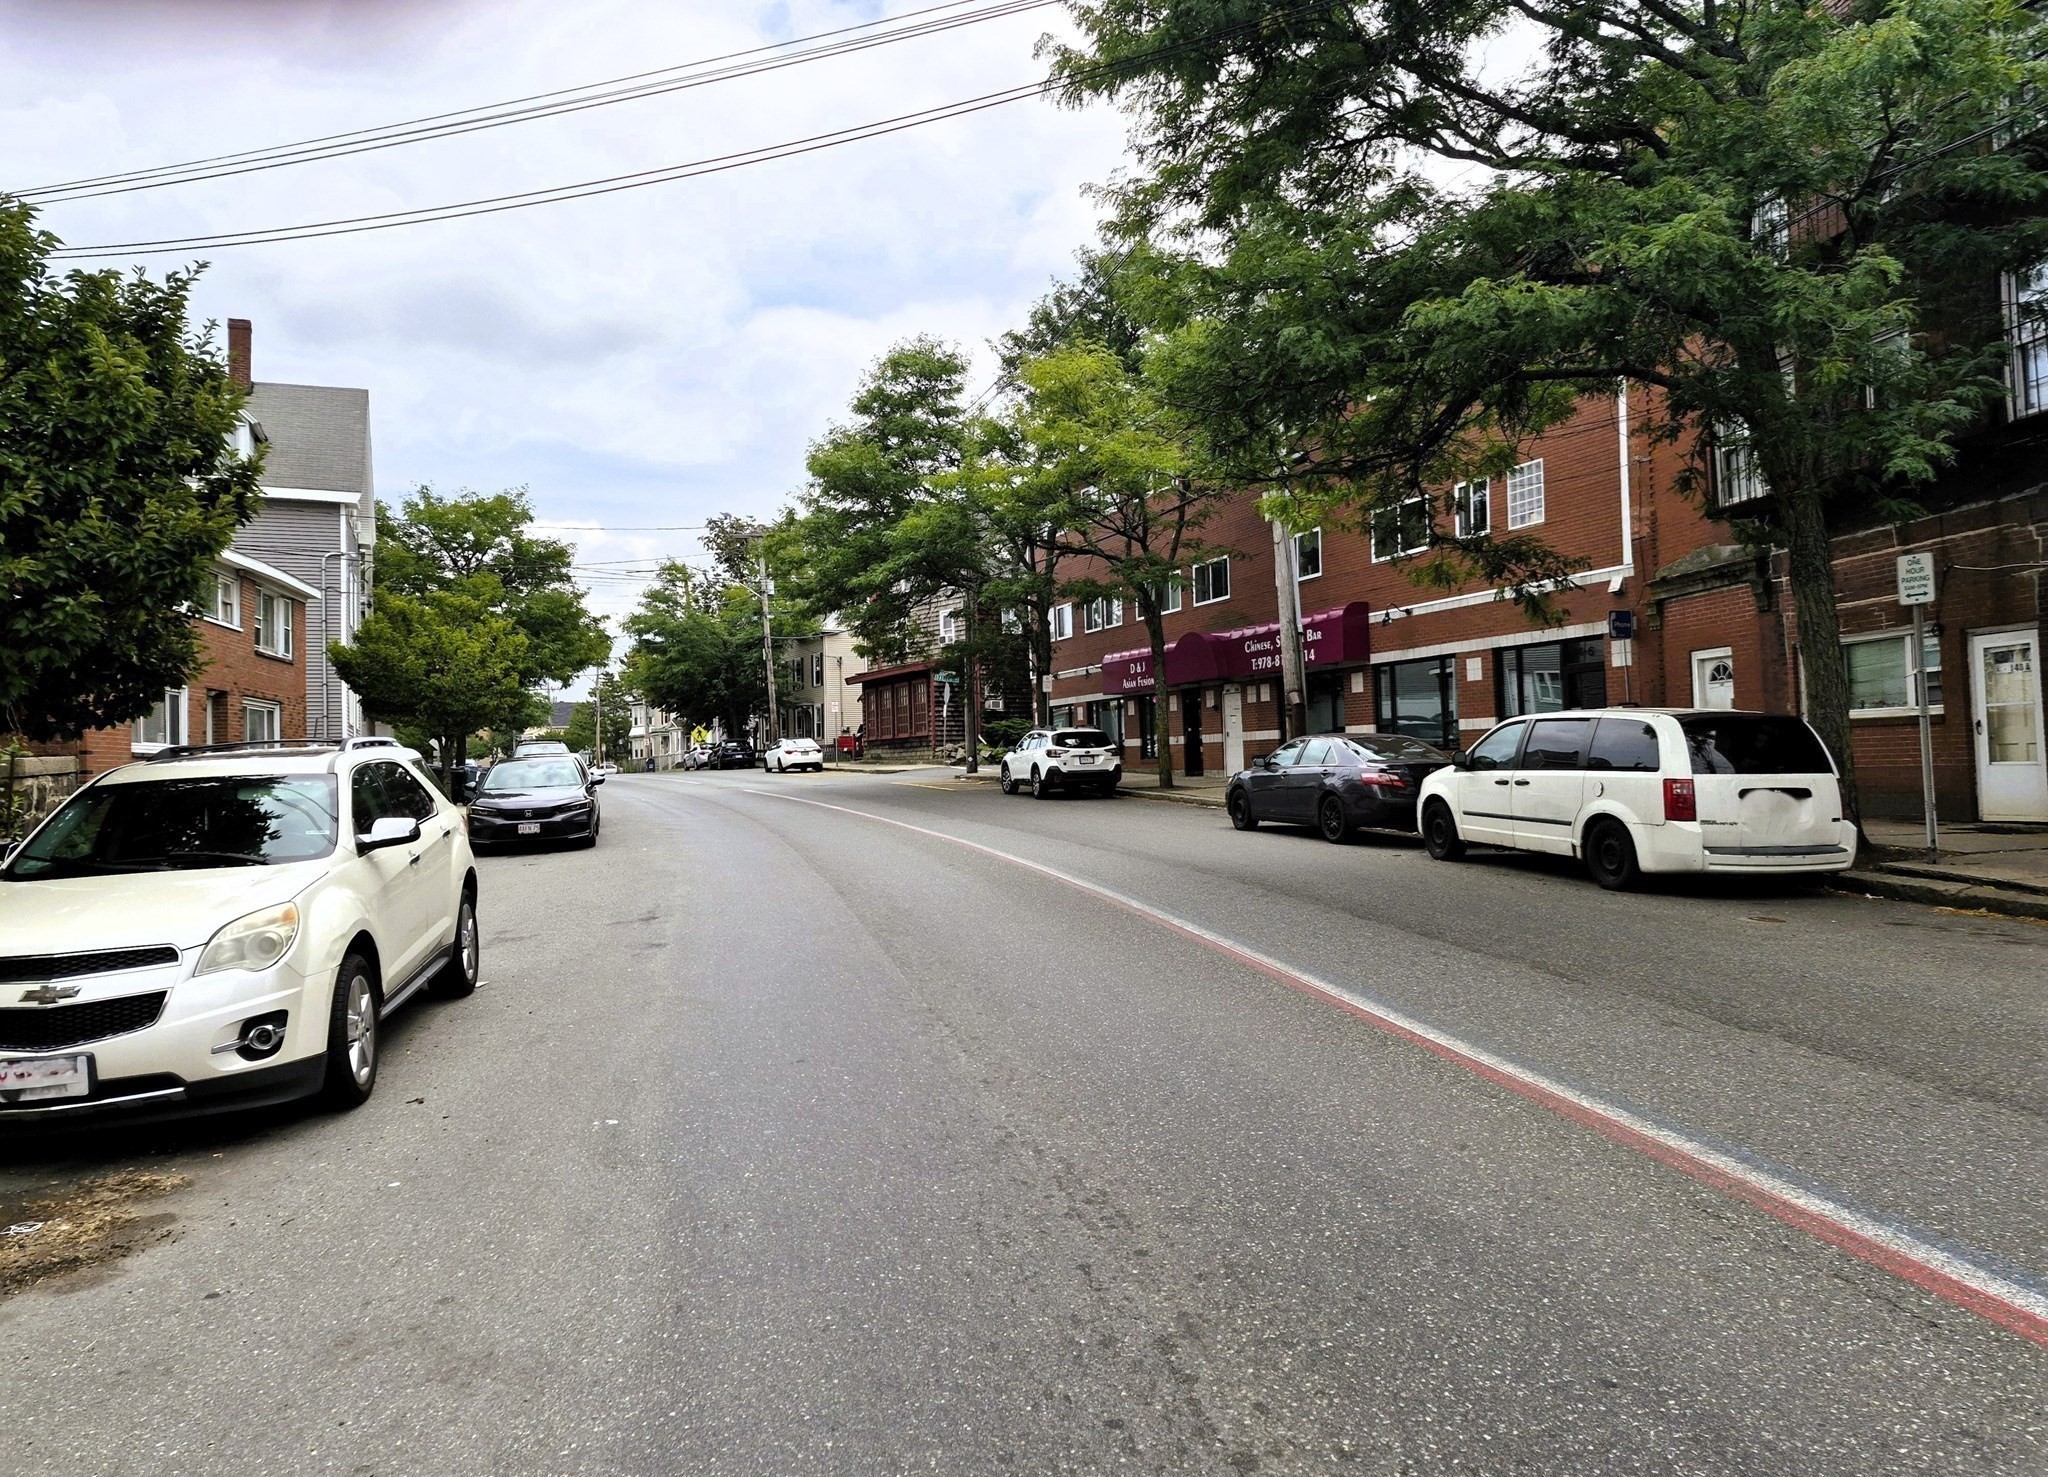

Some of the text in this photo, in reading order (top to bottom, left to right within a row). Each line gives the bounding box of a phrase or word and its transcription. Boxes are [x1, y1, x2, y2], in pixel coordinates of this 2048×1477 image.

[1905, 567, 1925, 575] HOUR
[1901, 574, 1930, 583] PARKING
[1130, 661, 1145, 674] D & J
